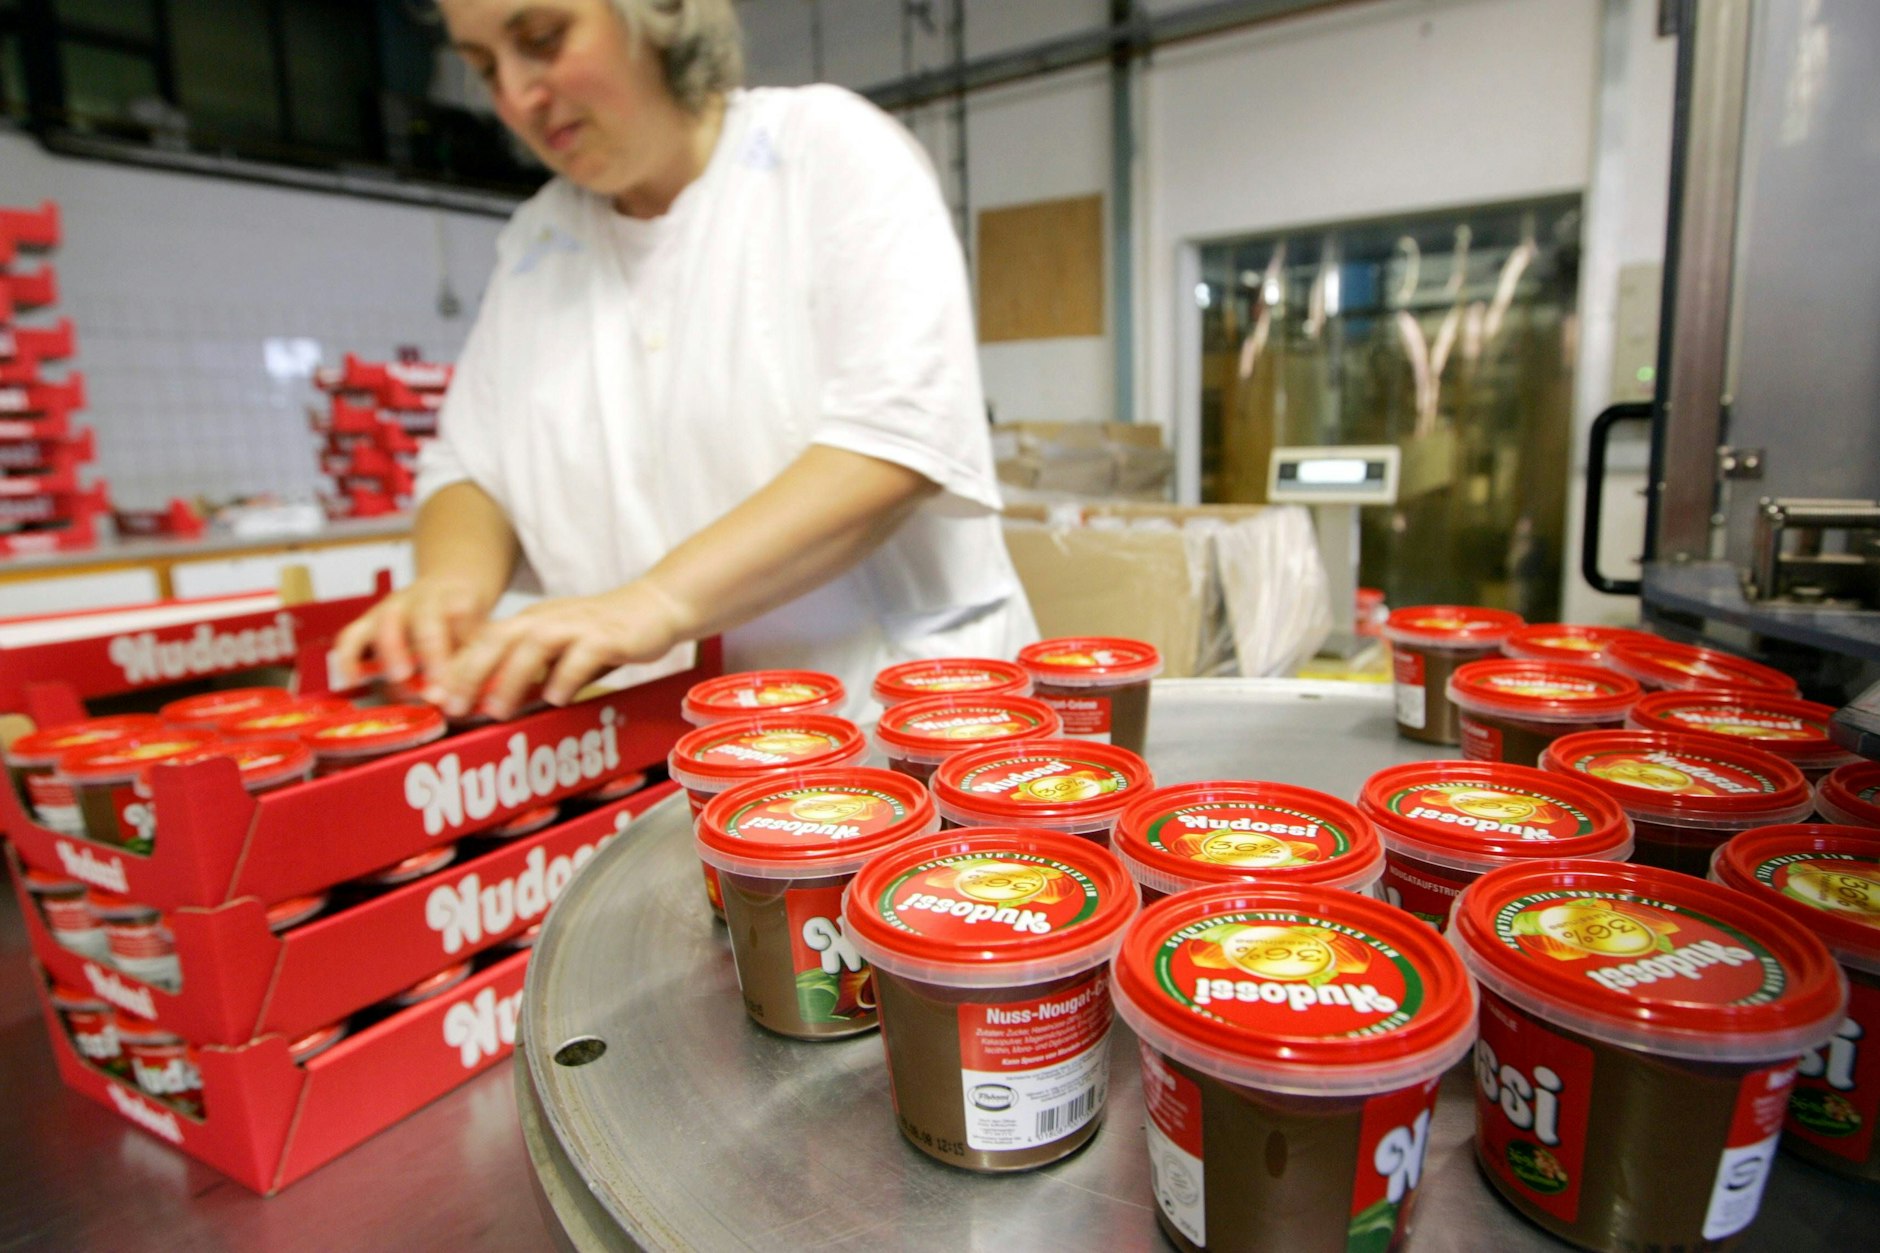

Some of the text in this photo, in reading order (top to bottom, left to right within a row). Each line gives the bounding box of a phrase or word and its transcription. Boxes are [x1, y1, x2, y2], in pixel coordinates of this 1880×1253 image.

[108, 612, 296, 684] Nudossi
[1672, 711, 1803, 730] Nudossi
[404, 706, 621, 836] Nudossi
[972, 760, 1073, 794] Nudossi
[1640, 750, 1761, 794] Nudossi
[739, 816, 863, 841] Nudossi
[1177, 814, 1320, 839] Nudossi
[1405, 806, 1558, 841] Nudossi
[1014, 853, 1046, 864] VIEL
[1209, 841, 1281, 855] 36%
[426, 810, 632, 954] Nudo
[1524, 892, 1560, 906] VIEL
[1566, 890, 1630, 902] EXTRA
[895, 892, 1053, 935] Nudossi
[1165, 913, 1401, 959] MIT EXTRA VIEL HASELNUSS
[1561, 917, 1637, 945] 36%
[1234, 946, 1324, 963] 36%
[1585, 939, 1757, 995] Nudossi
[1191, 977, 1399, 1014] Nudossi
